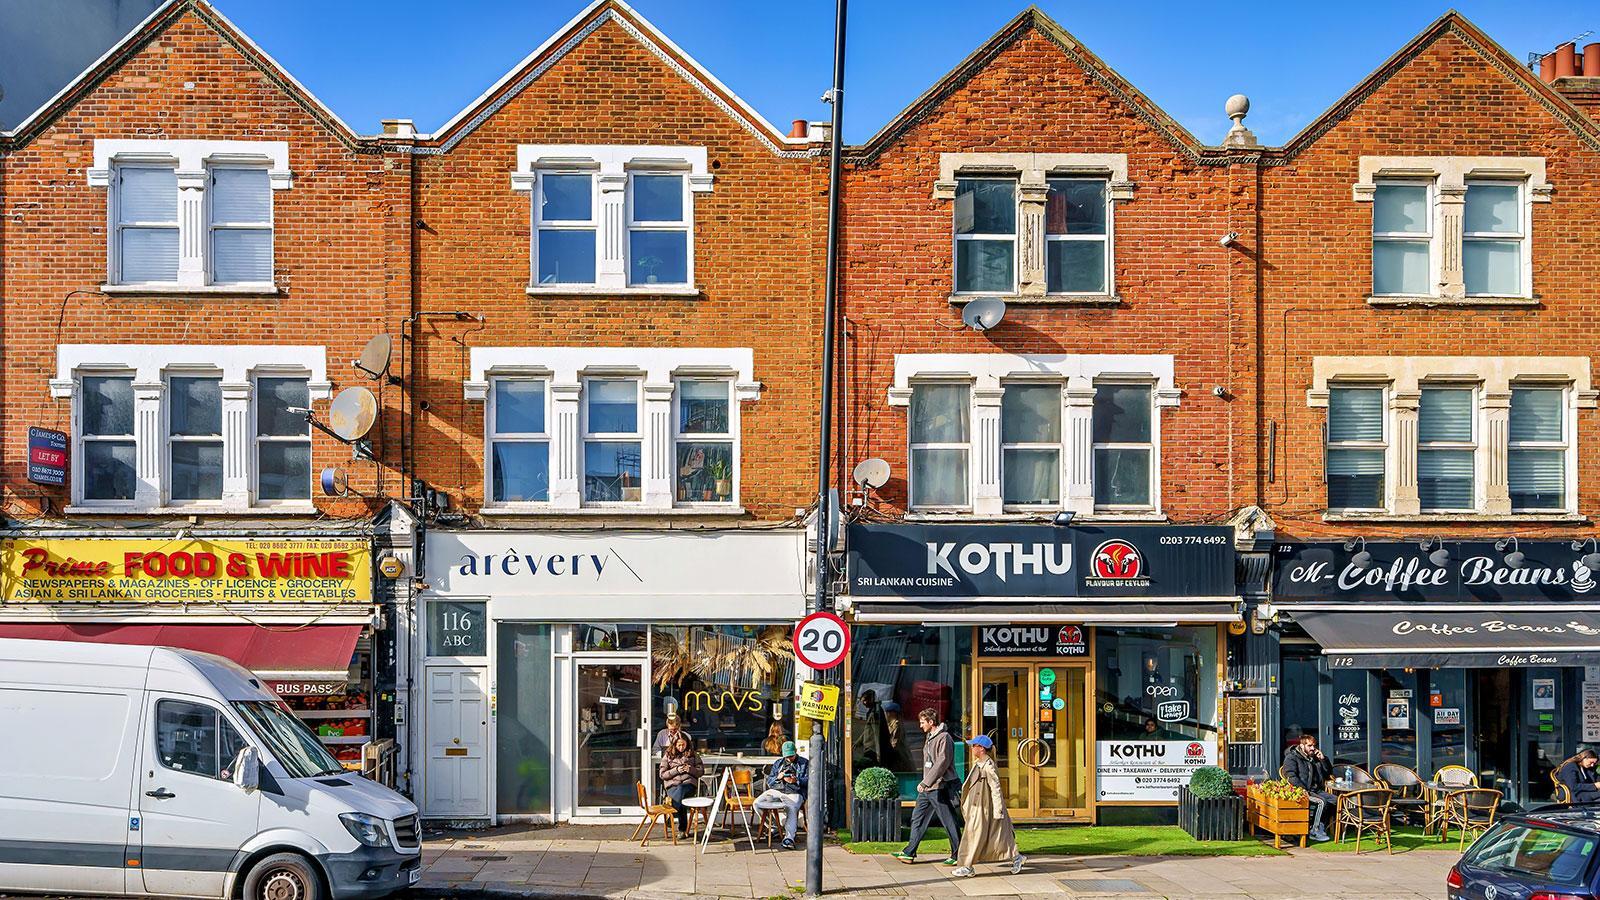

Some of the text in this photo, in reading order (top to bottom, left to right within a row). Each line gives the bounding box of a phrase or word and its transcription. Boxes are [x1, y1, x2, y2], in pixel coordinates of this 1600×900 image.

[38, 452, 59, 462] LET BY
[1160, 536, 1226, 544] 0203 774 6492
[22, 548, 349, 578] Prime FOOD & WINE
[926, 542, 1072, 582] KOTHU
[1461, 556, 1569, 585] Beans
[24, 580, 104, 588] NEWSPAPERS
[120, 580, 190, 588] MAGAZINES
[201, 580, 223, 588] OFF
[227, 580, 276, 588] LICENCE
[287, 580, 344, 588] GROCERY
[857, 577, 953, 586] SRI LANKAN CUISINE
[15, 590, 51, 598] ASIAN
[56, 590, 63, 598] &
[69, 590, 87, 598] SRI
[91, 590, 140, 598] LANKAN
[145, 590, 213, 598] GROCERIES
[223, 590, 264, 598] FRUITS
[280, 590, 356, 598] VEGETABLES
[442, 612, 471, 631] 116
[1392, 620, 1566, 635] Coffee Beans
[442, 635, 472, 646] ABC
[802, 629, 842, 653] 20
[983, 628, 1049, 646] KOTHU
[1056, 646, 1085, 655] KOTHU
[1334, 657, 1353, 666] 112
[1498, 654, 1557, 665] Coffee Beans
[276, 684, 333, 694] BUS PASS
[1147, 686, 1177, 697] open
[1339, 693, 1360, 706] Coffee
[802, 701, 834, 712] WARNING
[1165, 703, 1181, 712] take
[1110, 745, 1165, 759] KOTHU
